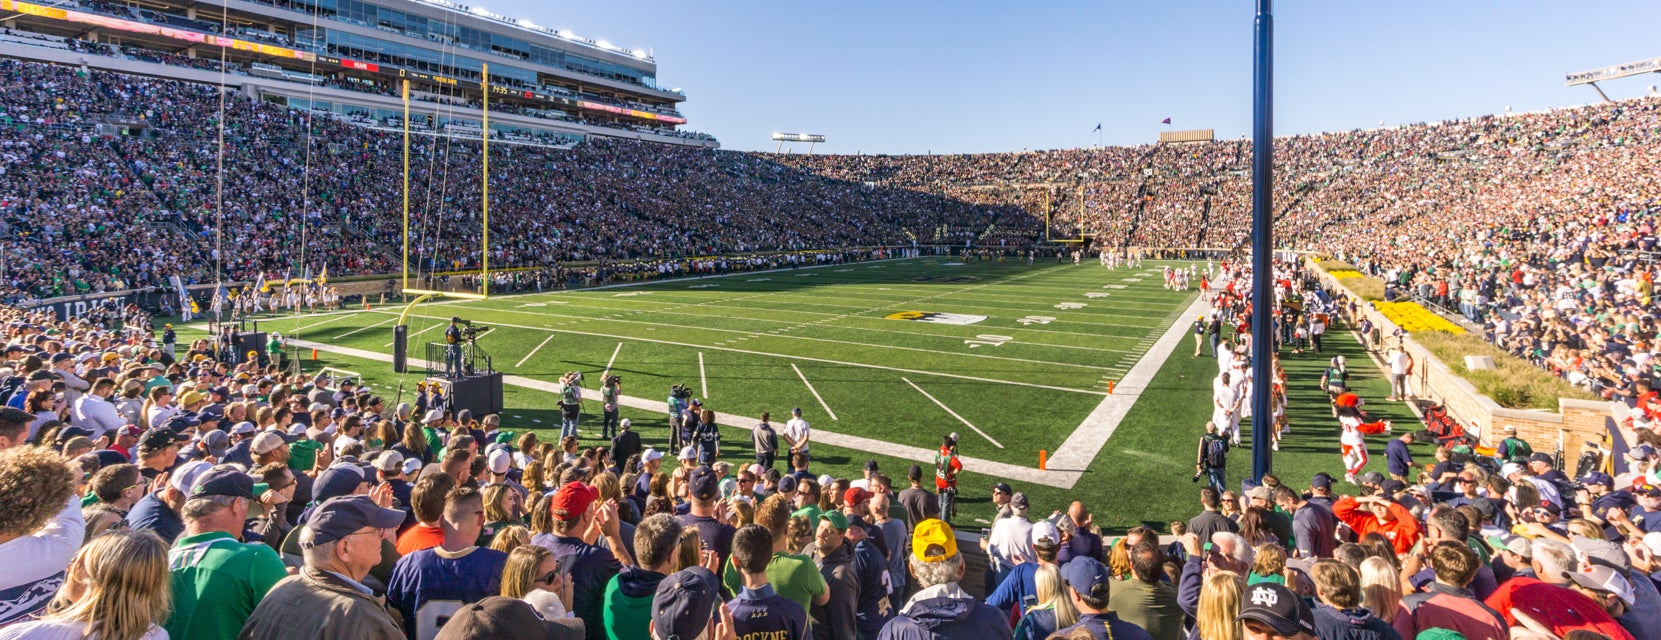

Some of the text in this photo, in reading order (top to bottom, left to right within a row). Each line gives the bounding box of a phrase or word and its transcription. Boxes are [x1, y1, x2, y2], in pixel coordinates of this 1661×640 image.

[353, 61, 368, 70] MIAMI
[964, 334, 1014, 347] 10
[736, 630, 788, 640] OCKNE
